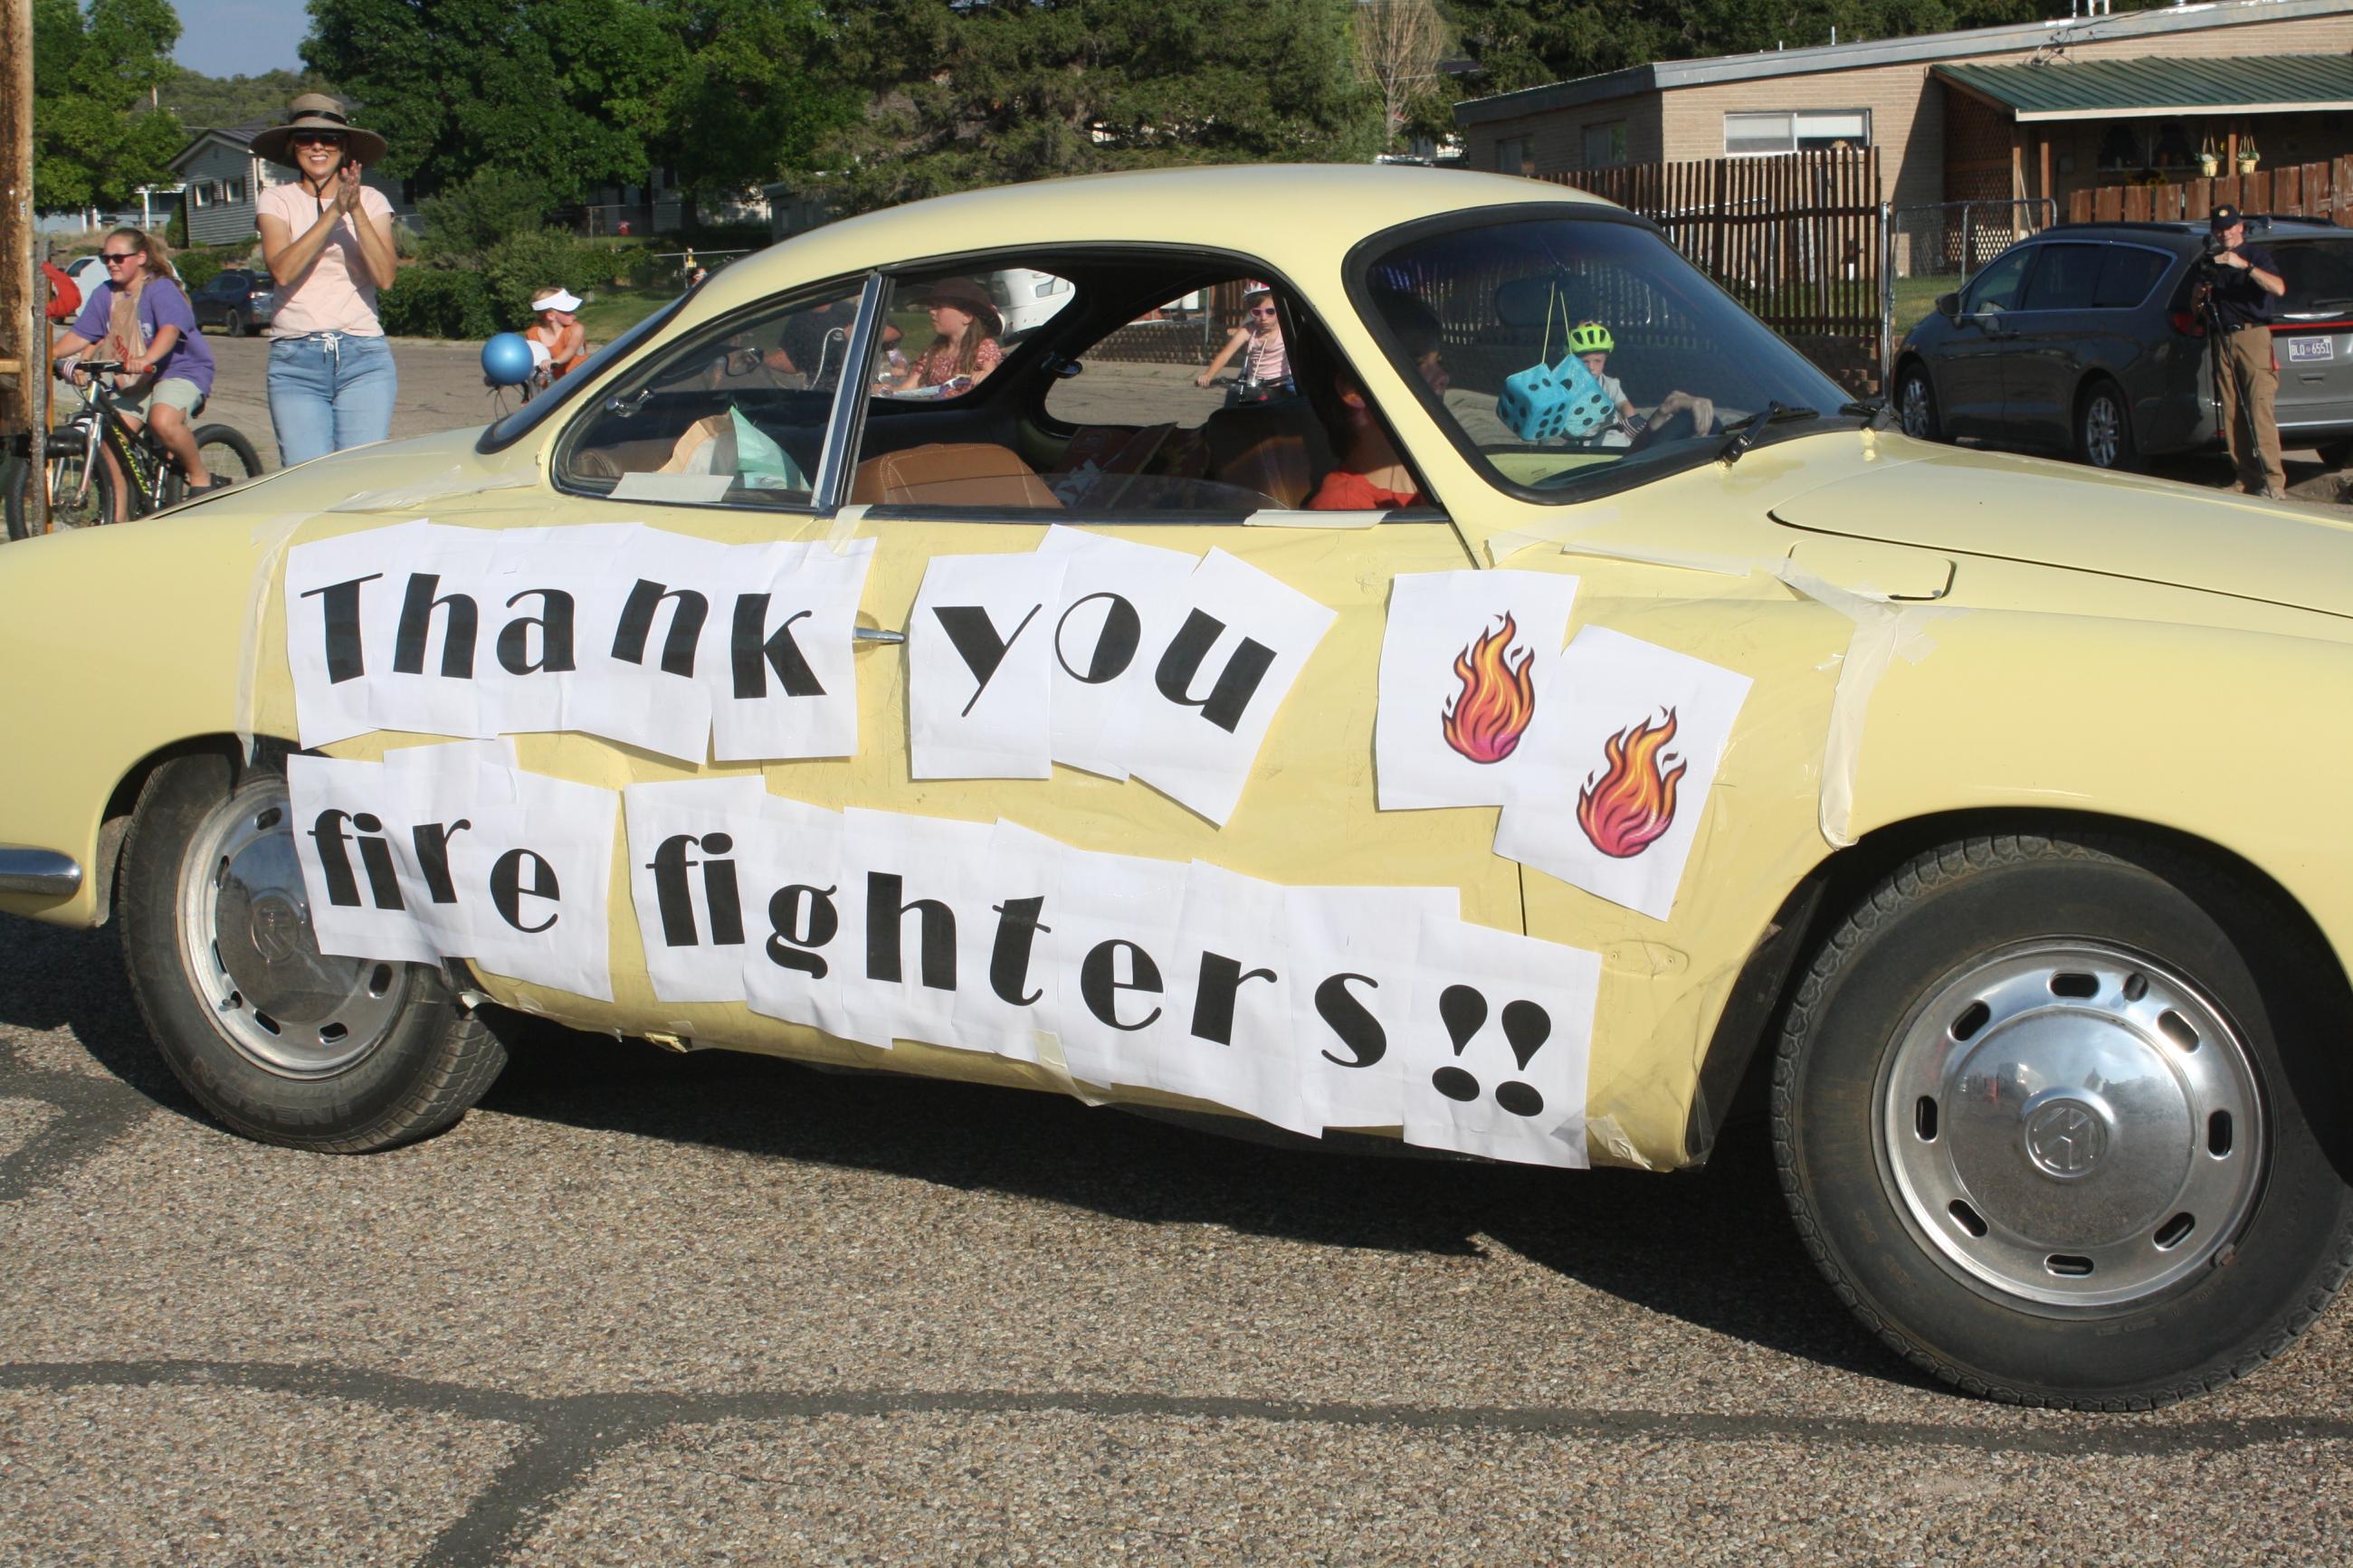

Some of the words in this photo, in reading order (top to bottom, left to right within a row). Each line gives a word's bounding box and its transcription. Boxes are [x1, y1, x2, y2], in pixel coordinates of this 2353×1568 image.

[2311, 342, 2329, 355] 6551
[301, 574, 825, 698] Thank
[933, 593, 1276, 732] you
[308, 810, 559, 933] fire
[646, 833, 1550, 1117] fighters!!
